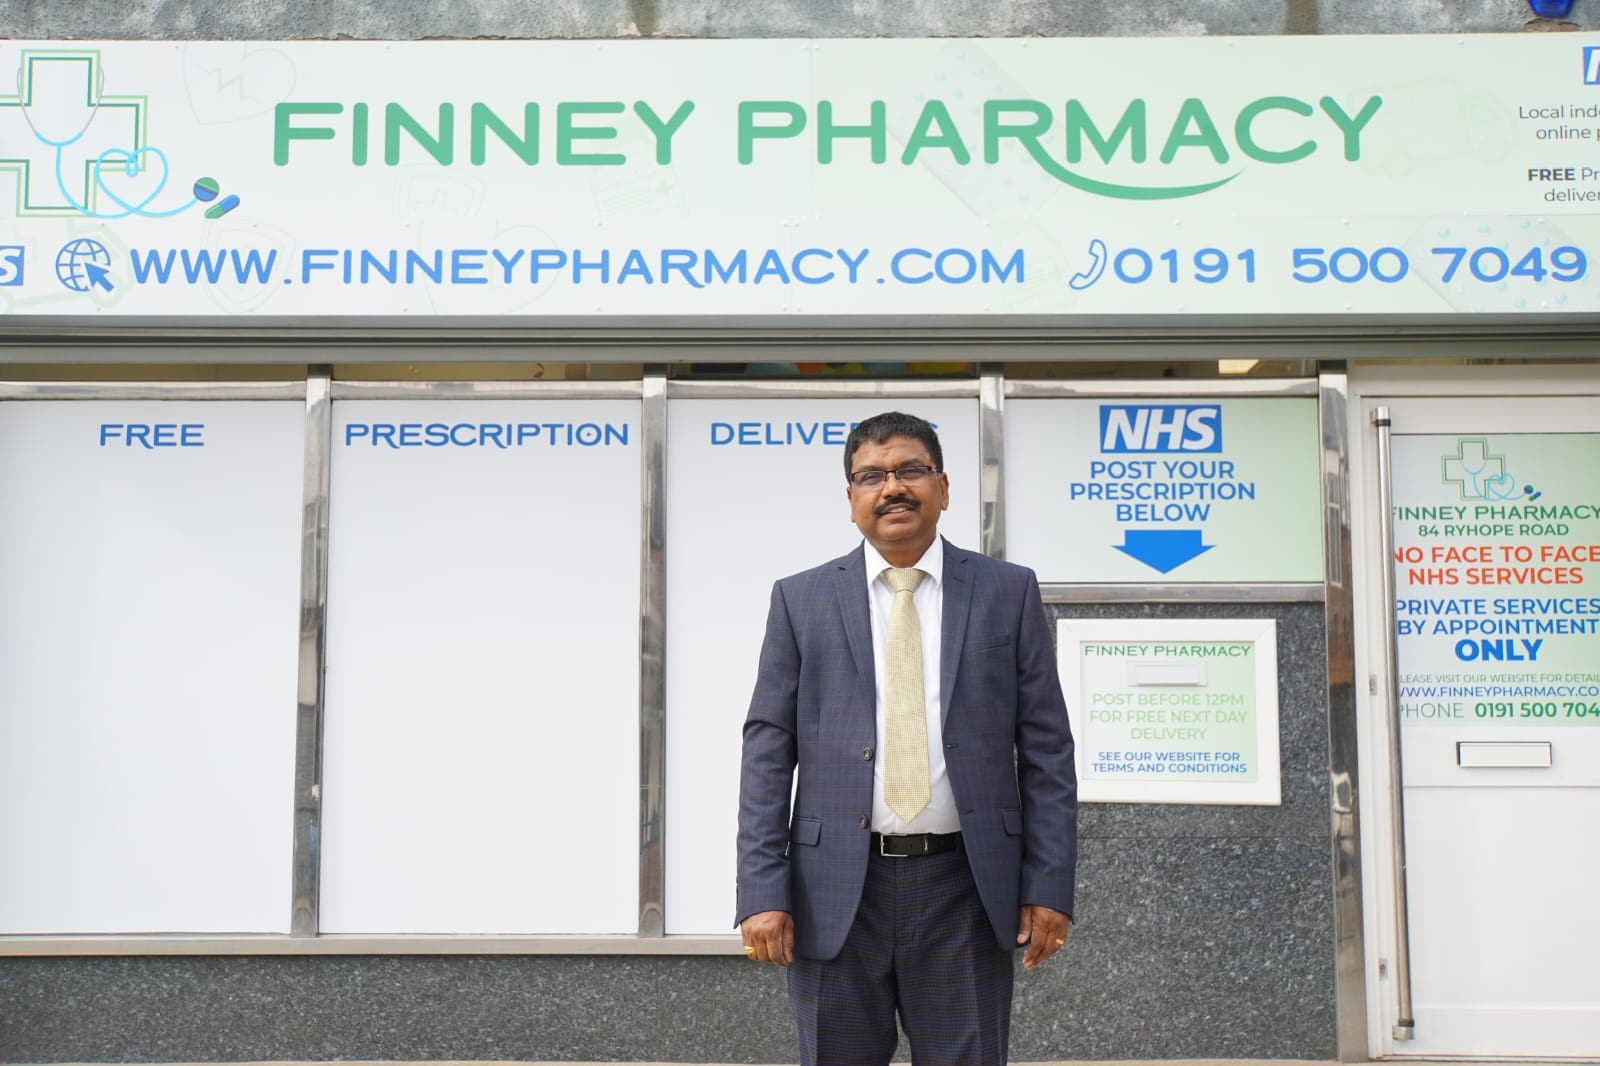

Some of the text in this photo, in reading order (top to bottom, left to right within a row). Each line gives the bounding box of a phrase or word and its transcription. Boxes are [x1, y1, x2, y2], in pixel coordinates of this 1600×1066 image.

[1519, 104, 1600, 119] Local ind
[1536, 125, 1591, 139] online
[273, 95, 1383, 200] FINNEY PHARMACY
[1528, 168, 1575, 181] FREE
[130, 247, 1025, 289] WWW.FINNEYPHARMACY.COM
[1113, 246, 1588, 285] 0191 500 7049
[99, 423, 205, 449] FREE
[345, 423, 629, 449] PRESCRIPTION
[1103, 407, 1218, 450] NHS
[1090, 461, 1235, 479] POST YOUR
[1070, 482, 1256, 500] PRESCRIPTION
[1116, 504, 1211, 522] BELOW
[1475, 504, 1600, 521] PHARMACY
[1418, 524, 1569, 537] 84 RYHOPE ROAD
[1431, 546, 1494, 563] FACE
[1499, 546, 1533, 563] TO
[1540, 545, 1600, 562] FACE
[1408, 567, 1584, 585] NHS SERVICES
[1493, 598, 1600, 614] SERVICES
[1397, 618, 1600, 635] BY APPOINTMENT
[1084, 645, 1251, 658] FINNEY PHARMACY
[1455, 638, 1543, 661] ONLY
[1436, 674, 1460, 683] VISIT
[1463, 674, 1488, 683] OUR
[1490, 673, 1537, 683] WEBSITE
[1541, 673, 1562, 683] FOR
[1092, 693, 1245, 706] POST BEFORE 12PM
[1090, 710, 1248, 723] FOR FREE NEXT DAY
[1474, 702, 1514, 718] 0191
[1520, 702, 1557, 717] 500
[1131, 728, 1208, 740] DELIVERY
[1098, 752, 1241, 761] SEE OUR WEBSITE FOR
[1092, 763, 1248, 773] TERMS AND CONDITIONS
